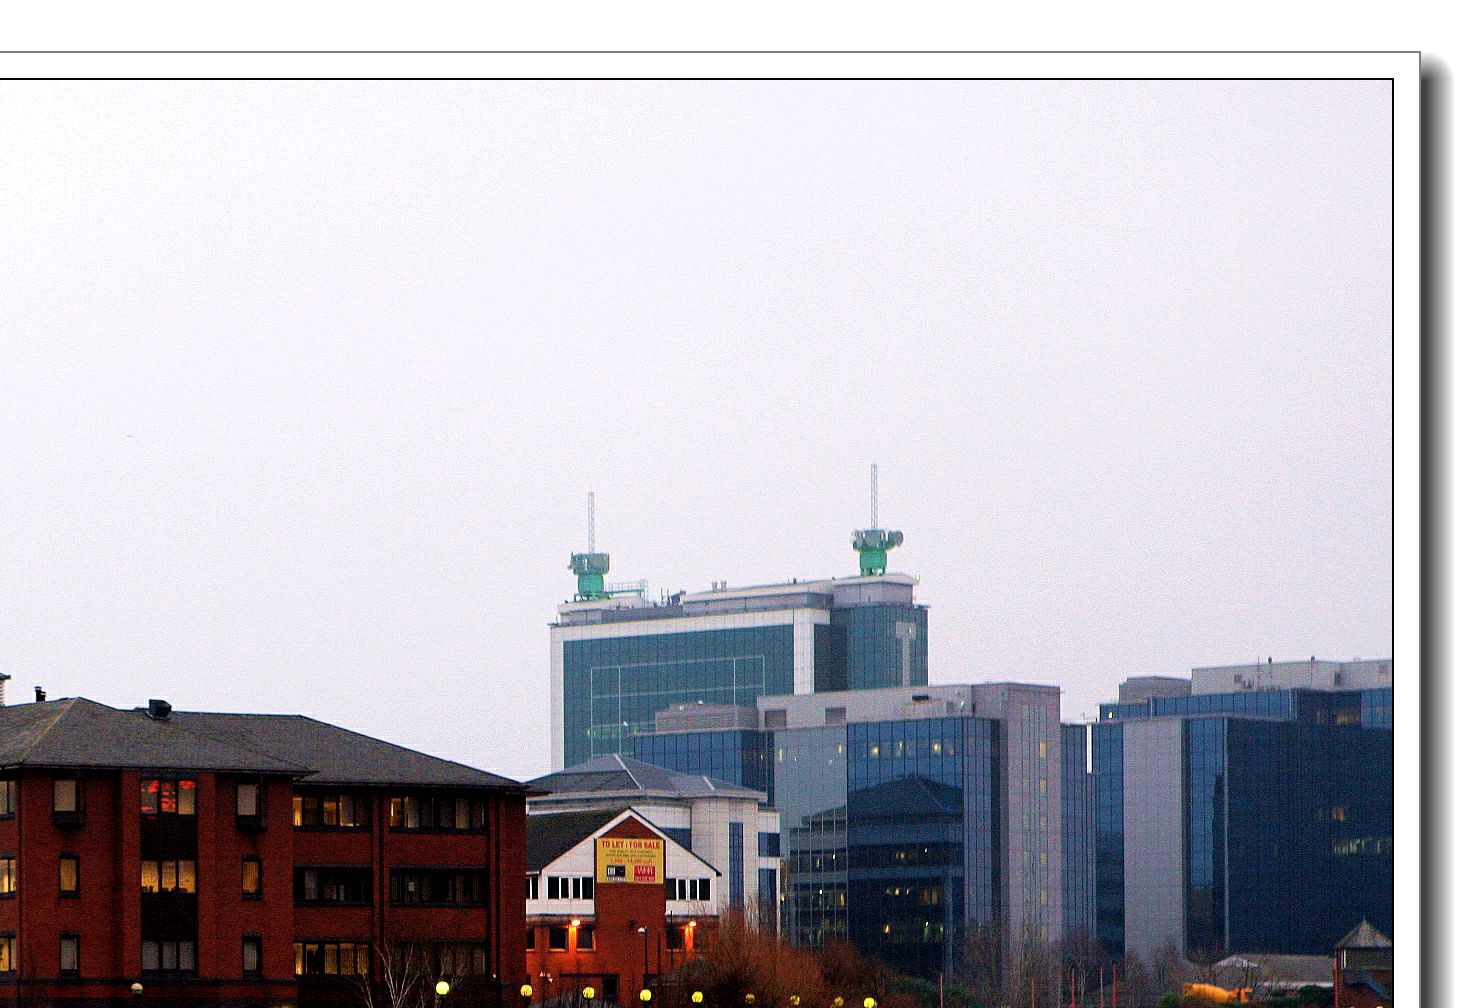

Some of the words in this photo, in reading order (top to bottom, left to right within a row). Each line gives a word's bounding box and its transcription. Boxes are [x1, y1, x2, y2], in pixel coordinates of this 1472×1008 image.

[602, 840, 610, 848] TO
[629, 841, 642, 849] FOR
[644, 841, 660, 849] SALE
